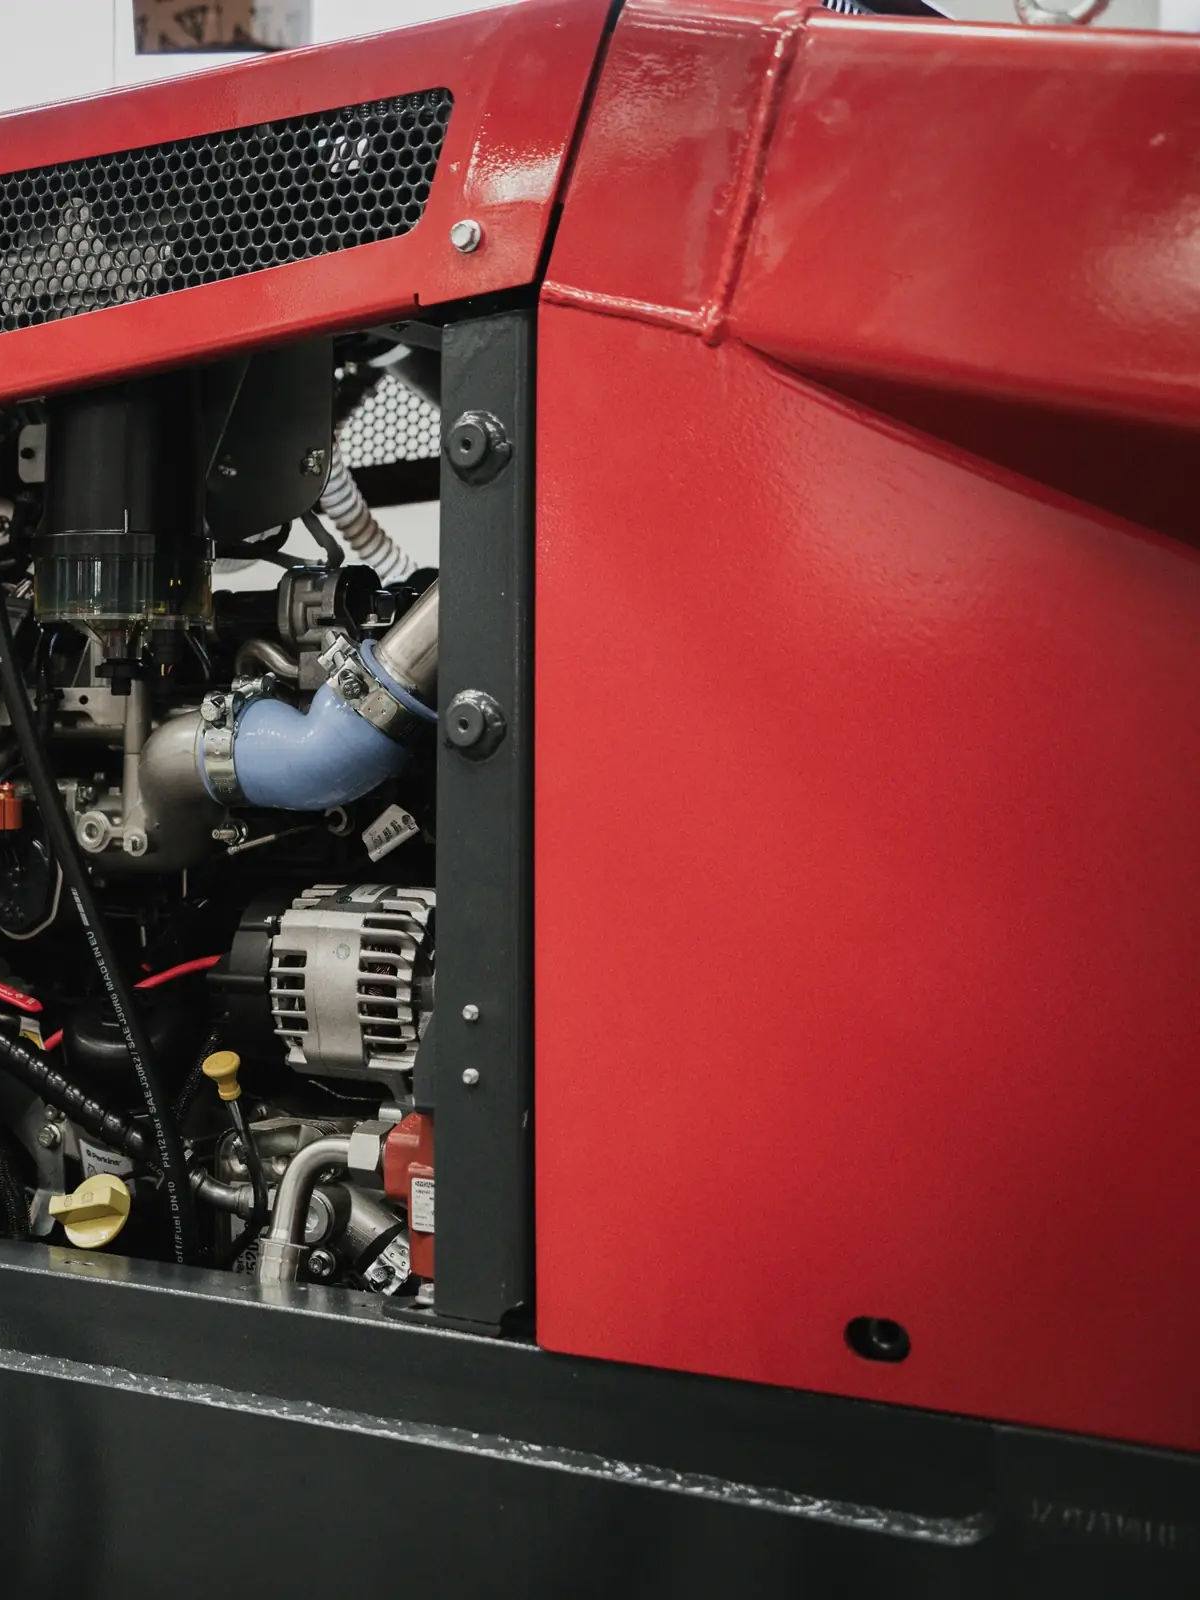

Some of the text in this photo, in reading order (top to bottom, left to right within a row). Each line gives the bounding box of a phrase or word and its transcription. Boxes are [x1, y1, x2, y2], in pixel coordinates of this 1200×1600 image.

[86, 931, 97, 946] EU
[92, 946, 102, 958] IN
[97, 958, 115, 991] MADE
[122, 1026, 136, 1049] SAE
[144, 1090, 157, 1114] SAE
[152, 1118, 164, 1138] bar
[157, 1138, 167, 1151] 12
[160, 1152, 171, 1168] PN
[167, 1181, 176, 1193] 10
[170, 1195, 179, 1211] DN
